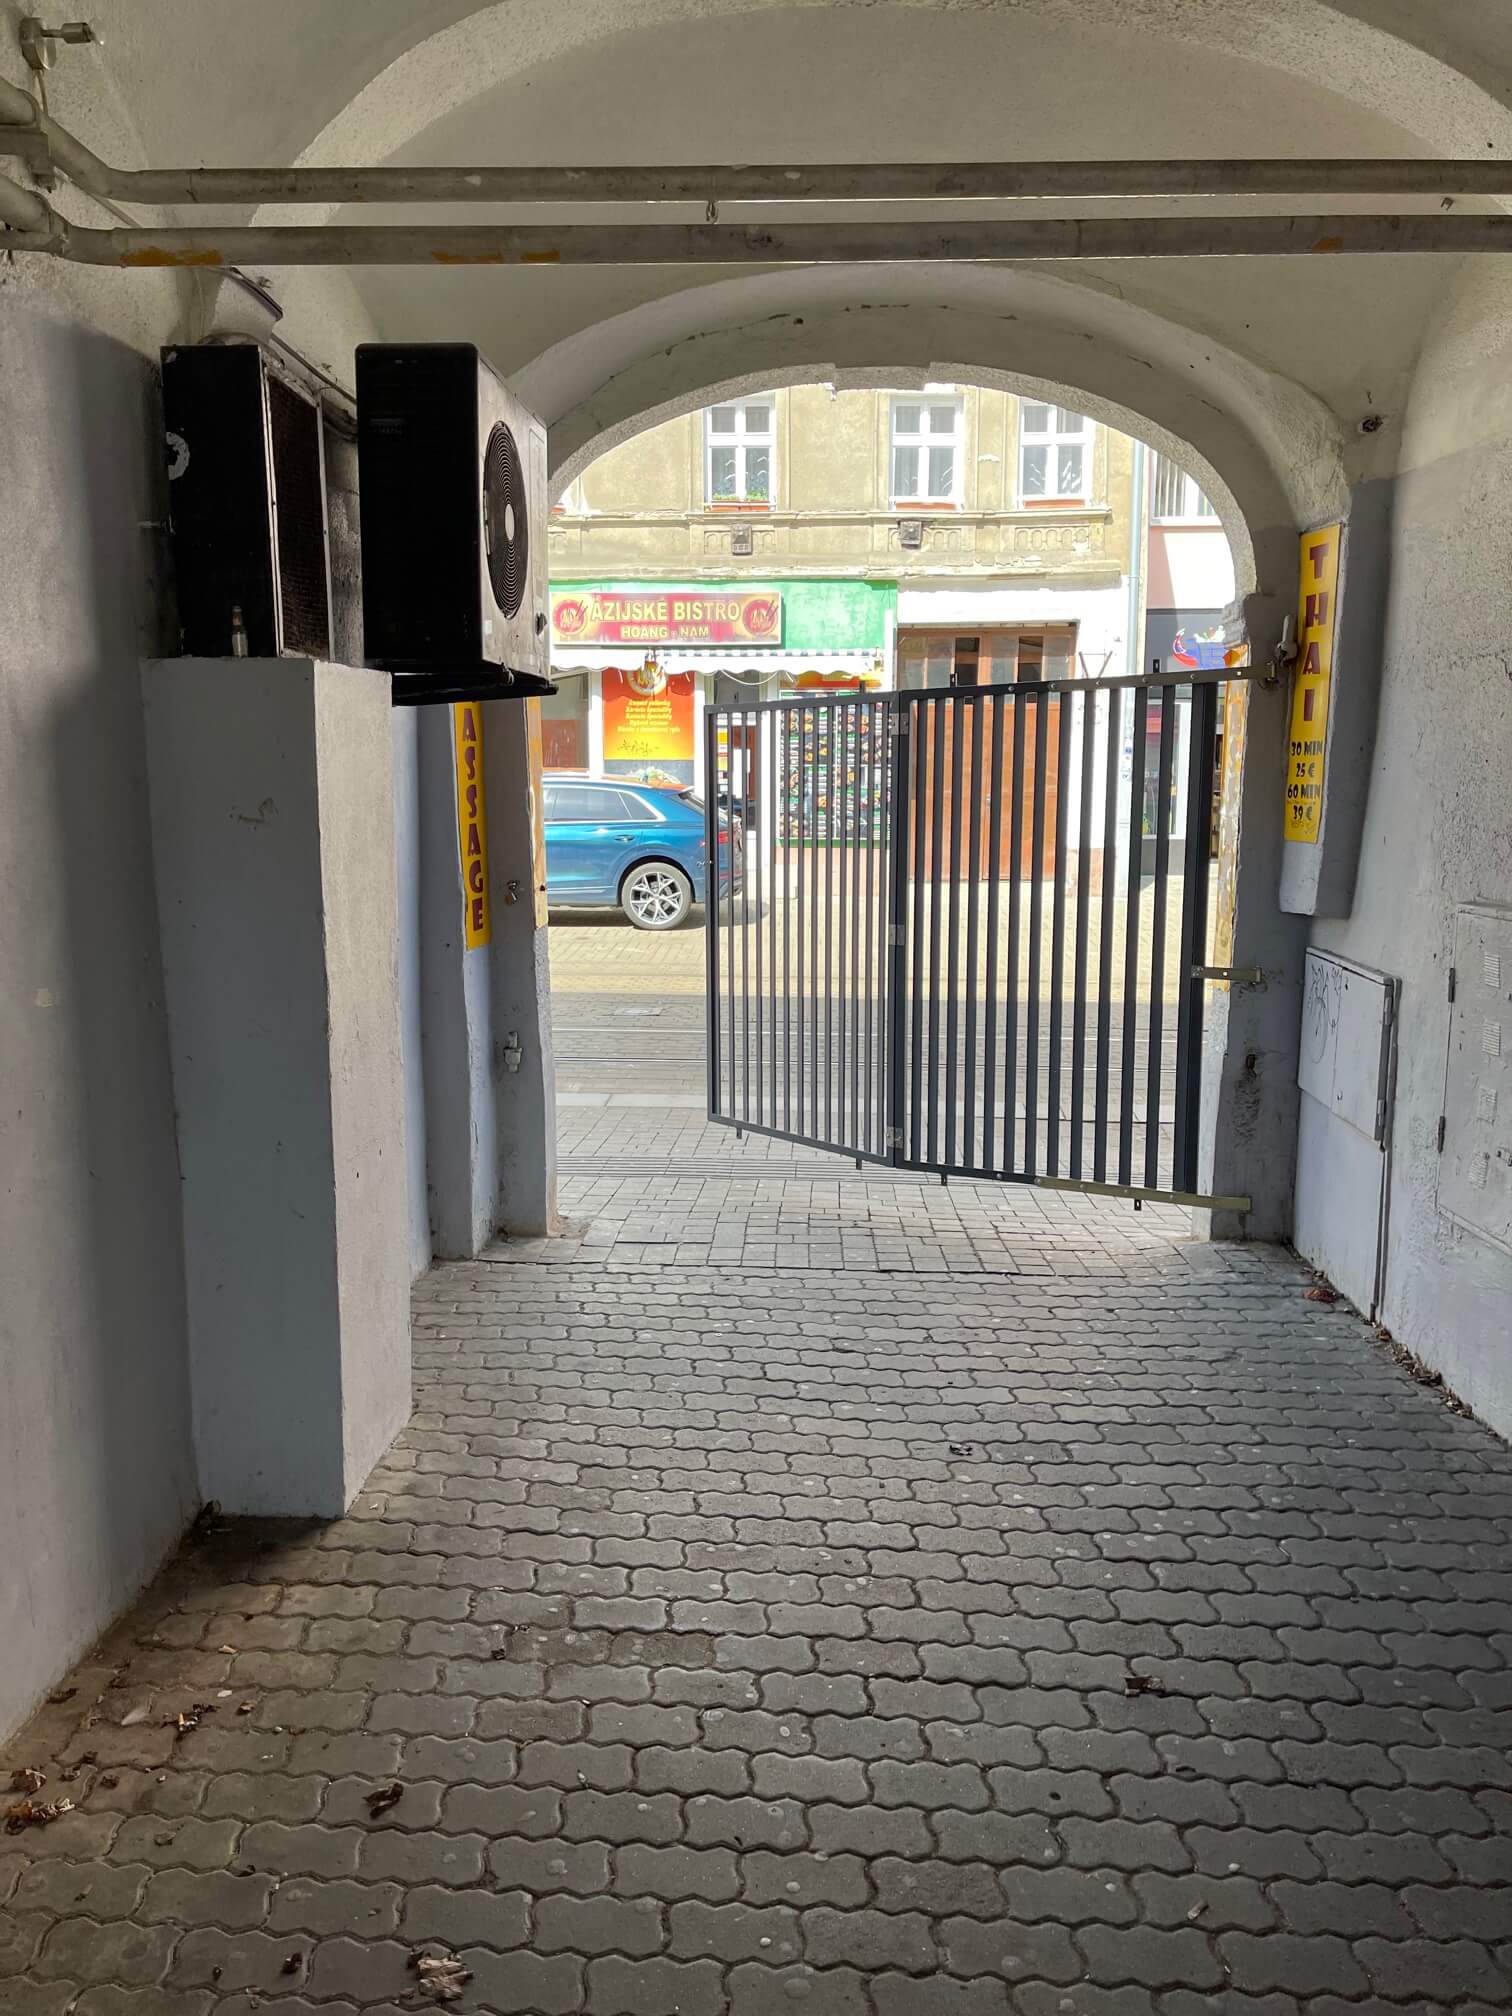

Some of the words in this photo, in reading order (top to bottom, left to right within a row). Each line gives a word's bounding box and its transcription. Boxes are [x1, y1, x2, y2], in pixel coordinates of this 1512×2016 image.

[673, 601, 740, 621] BISTRO
[621, 625, 668, 638] HOANG
[679, 625, 709, 638] NAM
[1302, 543, 1330, 722] THAI
[1291, 741, 1302, 756] 30
[1304, 741, 1323, 756] MIN
[1296, 763, 1306, 777] 25
[1307, 762, 1315, 777] €
[1287, 784, 1298, 799] 60
[1301, 784, 1321, 799] MIN
[462, 701, 484, 932] ASSAGE
[1293, 805, 1303, 820] 39
[1305, 806, 1313, 820] €
